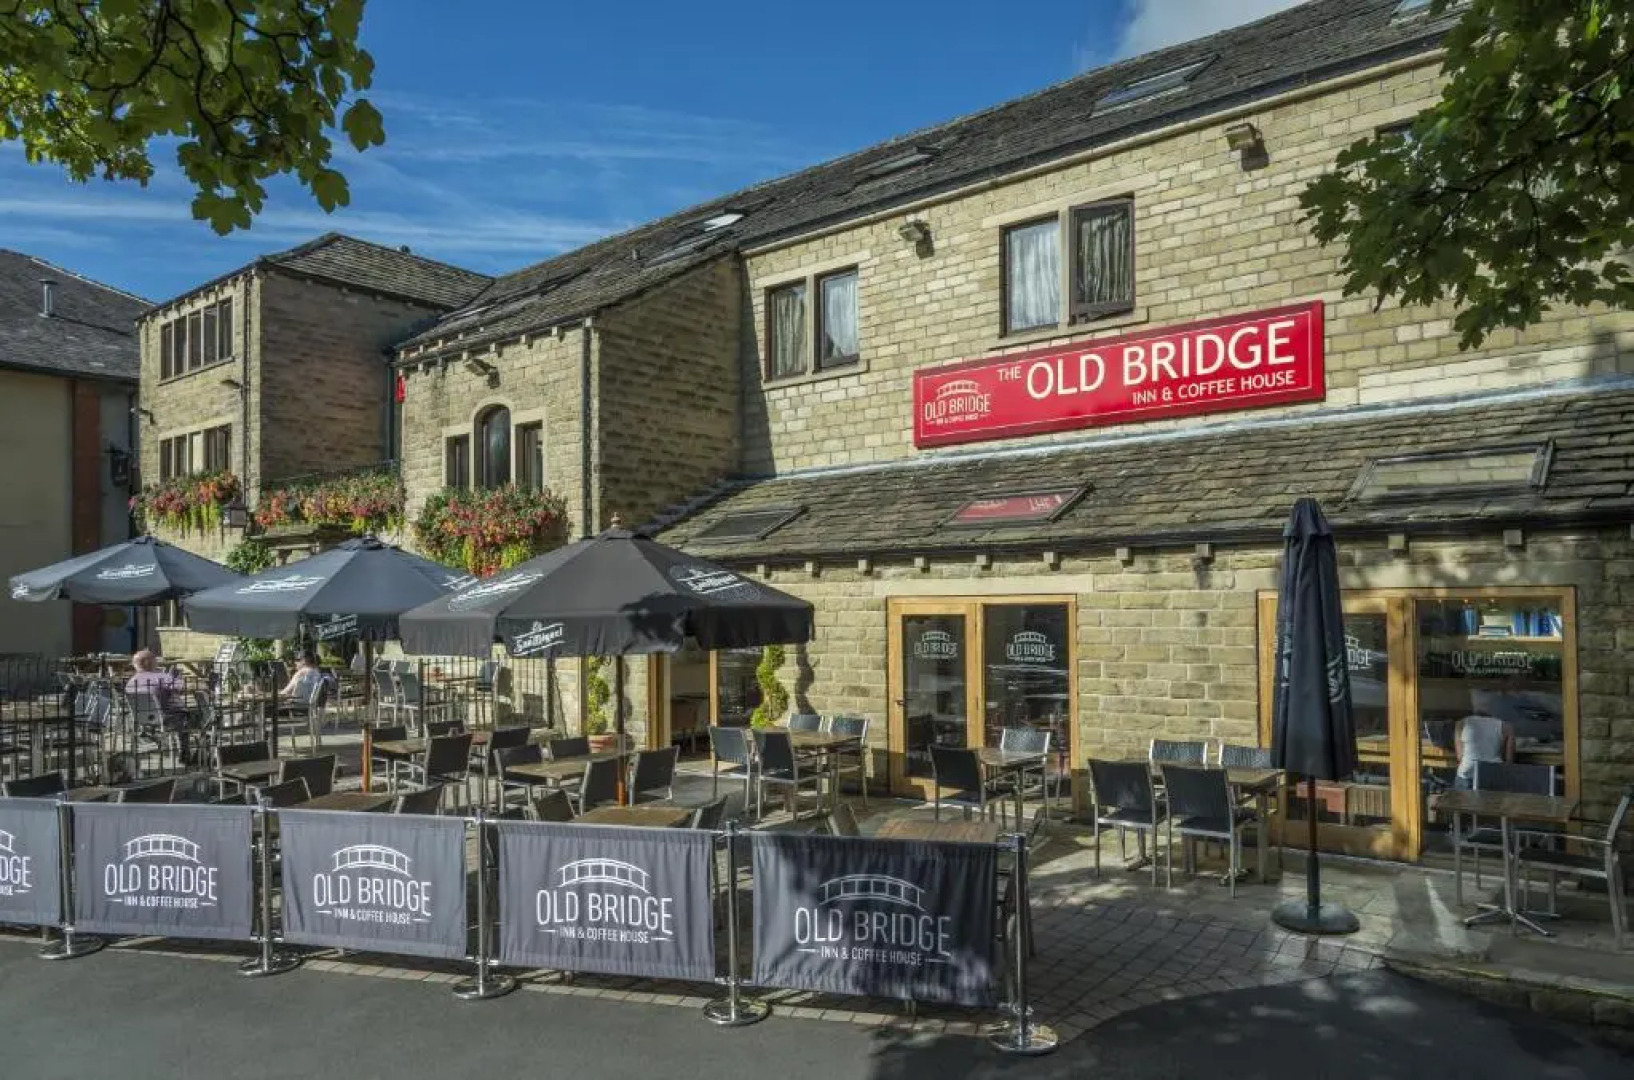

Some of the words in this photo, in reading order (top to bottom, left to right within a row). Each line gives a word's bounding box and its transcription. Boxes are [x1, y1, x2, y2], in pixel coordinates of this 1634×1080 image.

[998, 366, 1021, 383] THE
[1027, 353, 1105, 399] OLD
[1123, 320, 1295, 386] BRIDGE
[1132, 389, 1156, 405] INN
[1162, 386, 1173, 401] &
[1178, 378, 1236, 399] COFFEE
[1241, 370, 1296, 391] HOUSE
[925, 400, 947, 421] OLD
[949, 393, 991, 414] BRIDGE
[104, 864, 141, 895] OLD
[149, 864, 218, 900] BRIDGE
[314, 873, 351, 906] OLD
[358, 877, 432, 917] BRIDGE
[146, 896, 173, 908] COFFEE
[173, 897, 199, 909] HOUSE
[334, 908, 349, 919] INN
[357, 910, 384, 923] COFFEE
[385, 911, 411, 925] HOUSE
[537, 889, 579, 925] OLD
[588, 893, 673, 935] BRIDGE
[560, 926, 575, 939] INN
[578, 926, 585, 939] &
[586, 927, 618, 941] COFFEE
[620, 929, 649, 944] HOUSE
[795, 907, 843, 944] OLD
[854, 910, 951, 957] BRIDGE
[821, 945, 839, 958] INN
[841, 947, 849, 960] &
[851, 947, 887, 963] COFFEE
[890, 951, 922, 966] HOUSE
